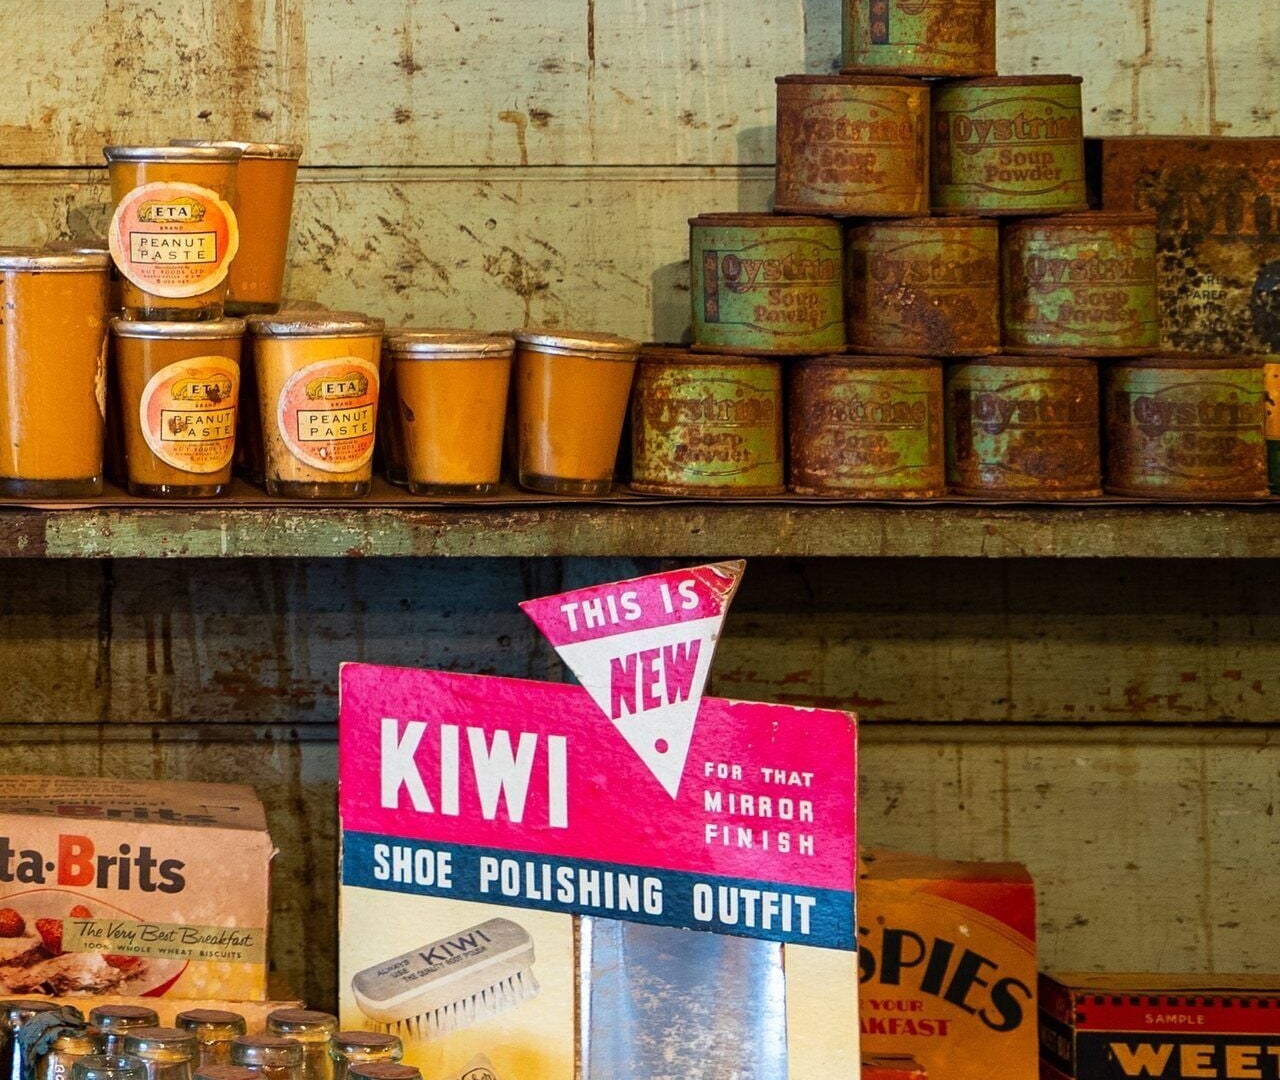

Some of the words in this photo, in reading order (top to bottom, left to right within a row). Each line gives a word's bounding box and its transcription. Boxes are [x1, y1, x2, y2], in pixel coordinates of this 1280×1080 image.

[999, 150, 1055, 168] Soup
[986, 164, 1062, 185] Powder
[155, 206, 188, 217] ETA
[140, 237, 205, 248] PEANUT
[140, 249, 206, 260] PASTE
[326, 382, 358, 393] ETA
[309, 410, 368, 424] PEANUT
[310, 423, 368, 436] PASTE
[560, 591, 643, 633] THIS
[662, 579, 700, 615] IS
[609, 638, 702, 721] NEW
[380, 717, 569, 830] KIWI
[704, 761, 742, 781] FOR
[760, 767, 814, 788] THAT
[704, 791, 814, 823] MIRROR
[704, 823, 815, 857] FINISH
[373, 843, 453, 890] SHOE
[479, 855, 663, 915] POLISHING
[693, 883, 817, 936] OUTFIT
[72, 921, 104, 938] The
[105, 922, 137, 943] Very
[140, 924, 177, 943] Best
[180, 926, 255, 948] Breakfast
[117, 944, 154, 953] WHOLE
[158, 947, 196, 956] WHEAT
[199, 949, 243, 959] BISCUITS
[419, 930, 491, 965] KIWI
[869, 1000, 924, 1011] YOUR
[1145, 1013, 1205, 1025] SAMPLE
